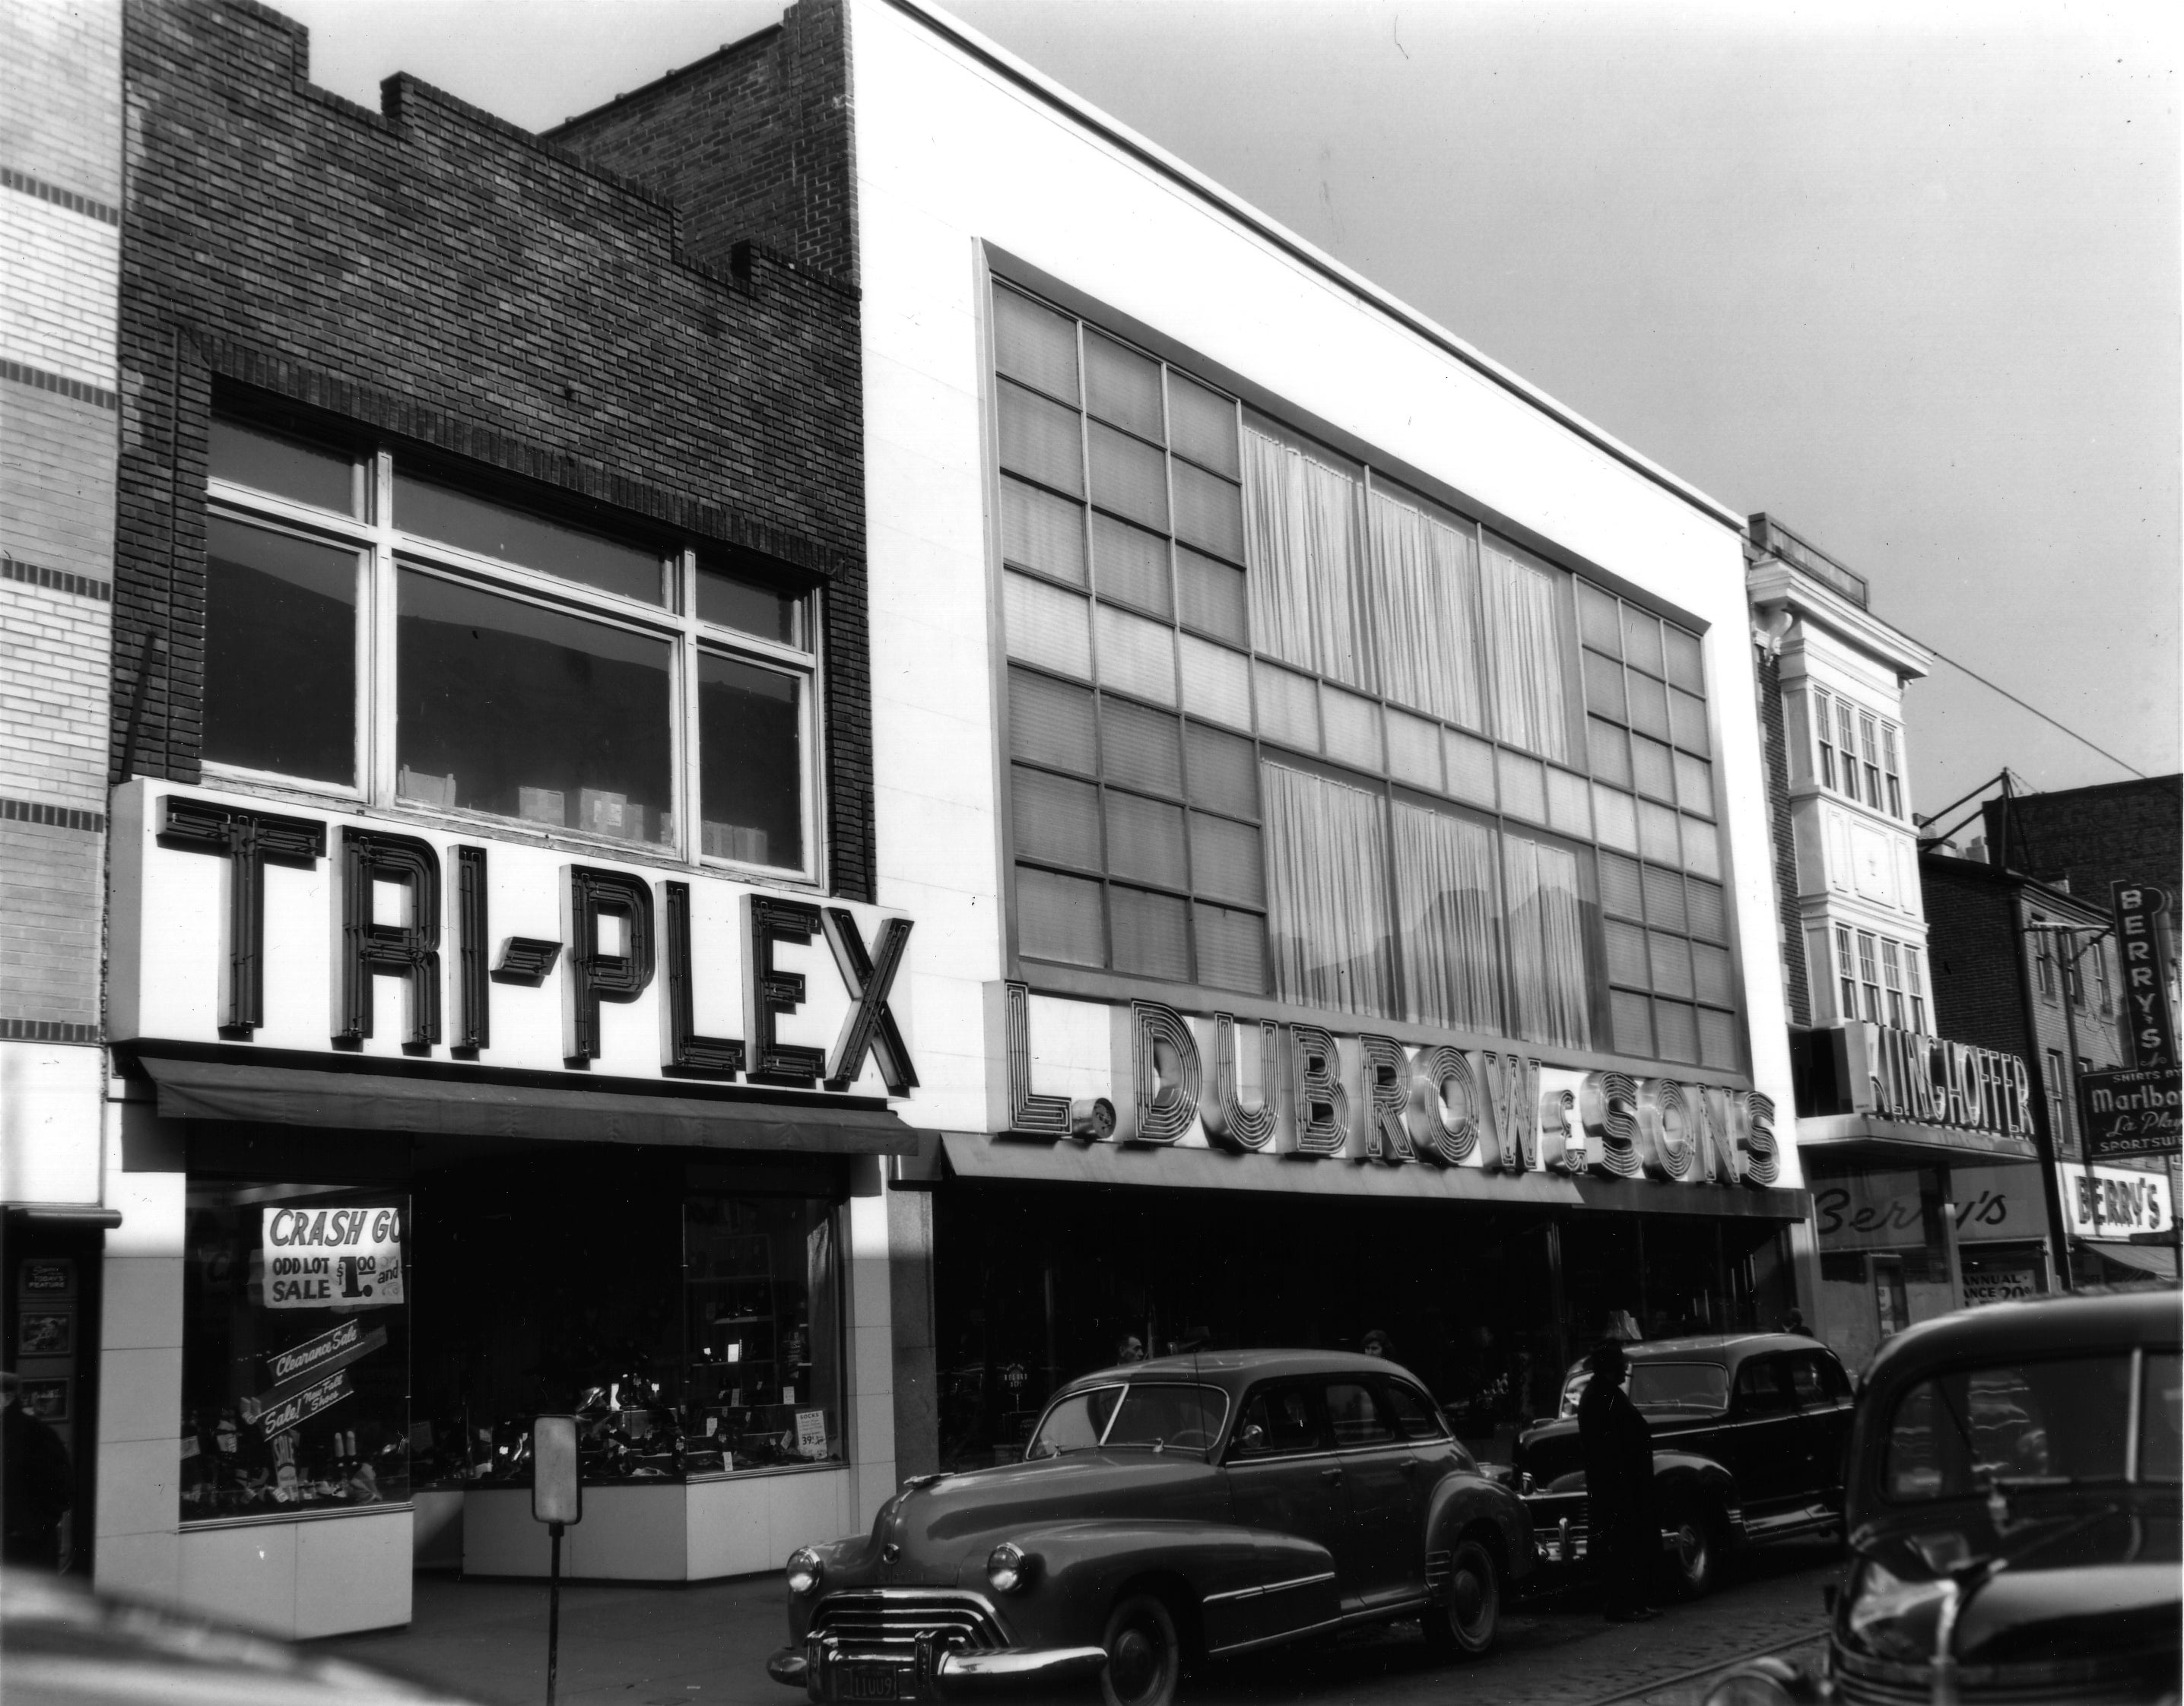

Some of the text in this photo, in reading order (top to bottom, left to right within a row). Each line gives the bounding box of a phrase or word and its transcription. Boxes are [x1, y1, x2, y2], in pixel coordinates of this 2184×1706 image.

[156, 794, 919, 1096] TRI-PLEX
[2120, 889, 2161, 1049] BERRY'S
[1005, 979, 1116, 1140] L.
[1130, 998, 1541, 1169] DUBROW
[1591, 1071, 1780, 1188] SONS
[1865, 1023, 2036, 1136] KLINGHOFFER
[2113, 1070, 2160, 1083] SHIRTS
[1815, 1188, 2006, 1235] Bery's
[2074, 1176, 2160, 1229] BERRY'S
[270, 1208, 368, 1247] CRASH
[272, 1257, 330, 1276] ODD LOT
[377, 1260, 398, 1284] and
[272, 1279, 332, 1302] SALE
[275, 1324, 357, 1377] Clearance Sale
[264, 1398, 301, 1434] Sale!
